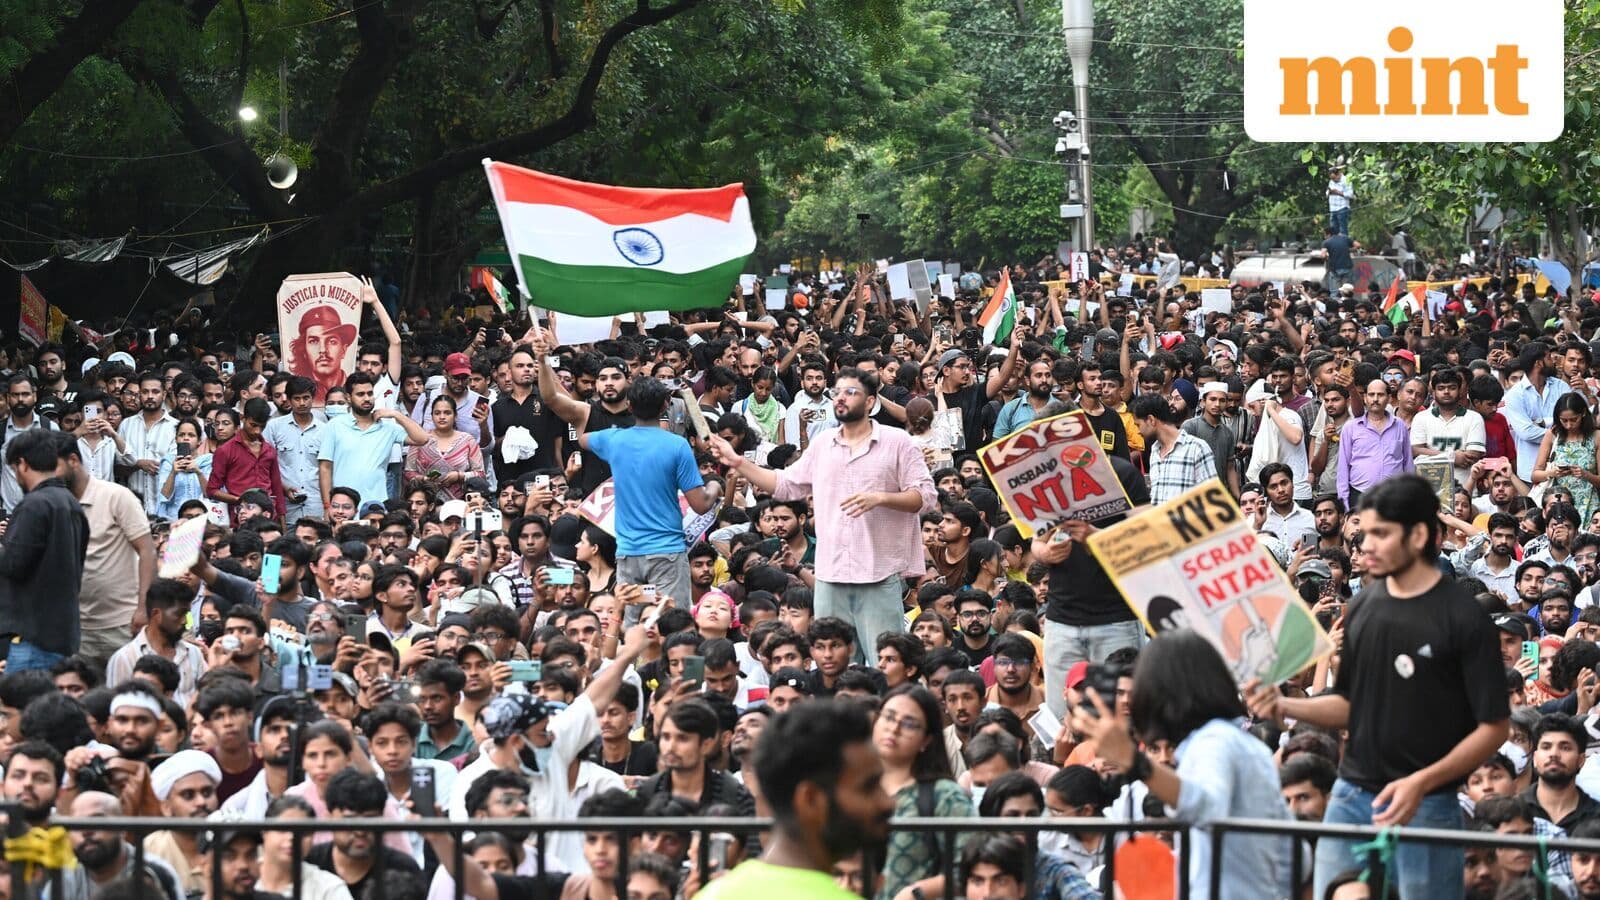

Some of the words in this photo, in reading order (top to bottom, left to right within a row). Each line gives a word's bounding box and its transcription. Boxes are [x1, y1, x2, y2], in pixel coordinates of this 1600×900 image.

[282, 285, 318, 314] JUSTICIA
[320, 284, 326, 297] O
[328, 285, 360, 310] MUERTE
[987, 415, 1084, 467] KYS
[1007, 457, 1058, 490] DISBAND
[1012, 466, 1106, 521] NTA
[1167, 487, 1237, 544] KYS
[1181, 533, 1257, 580] SCRAP
[1197, 557, 1276, 608] NTA!
